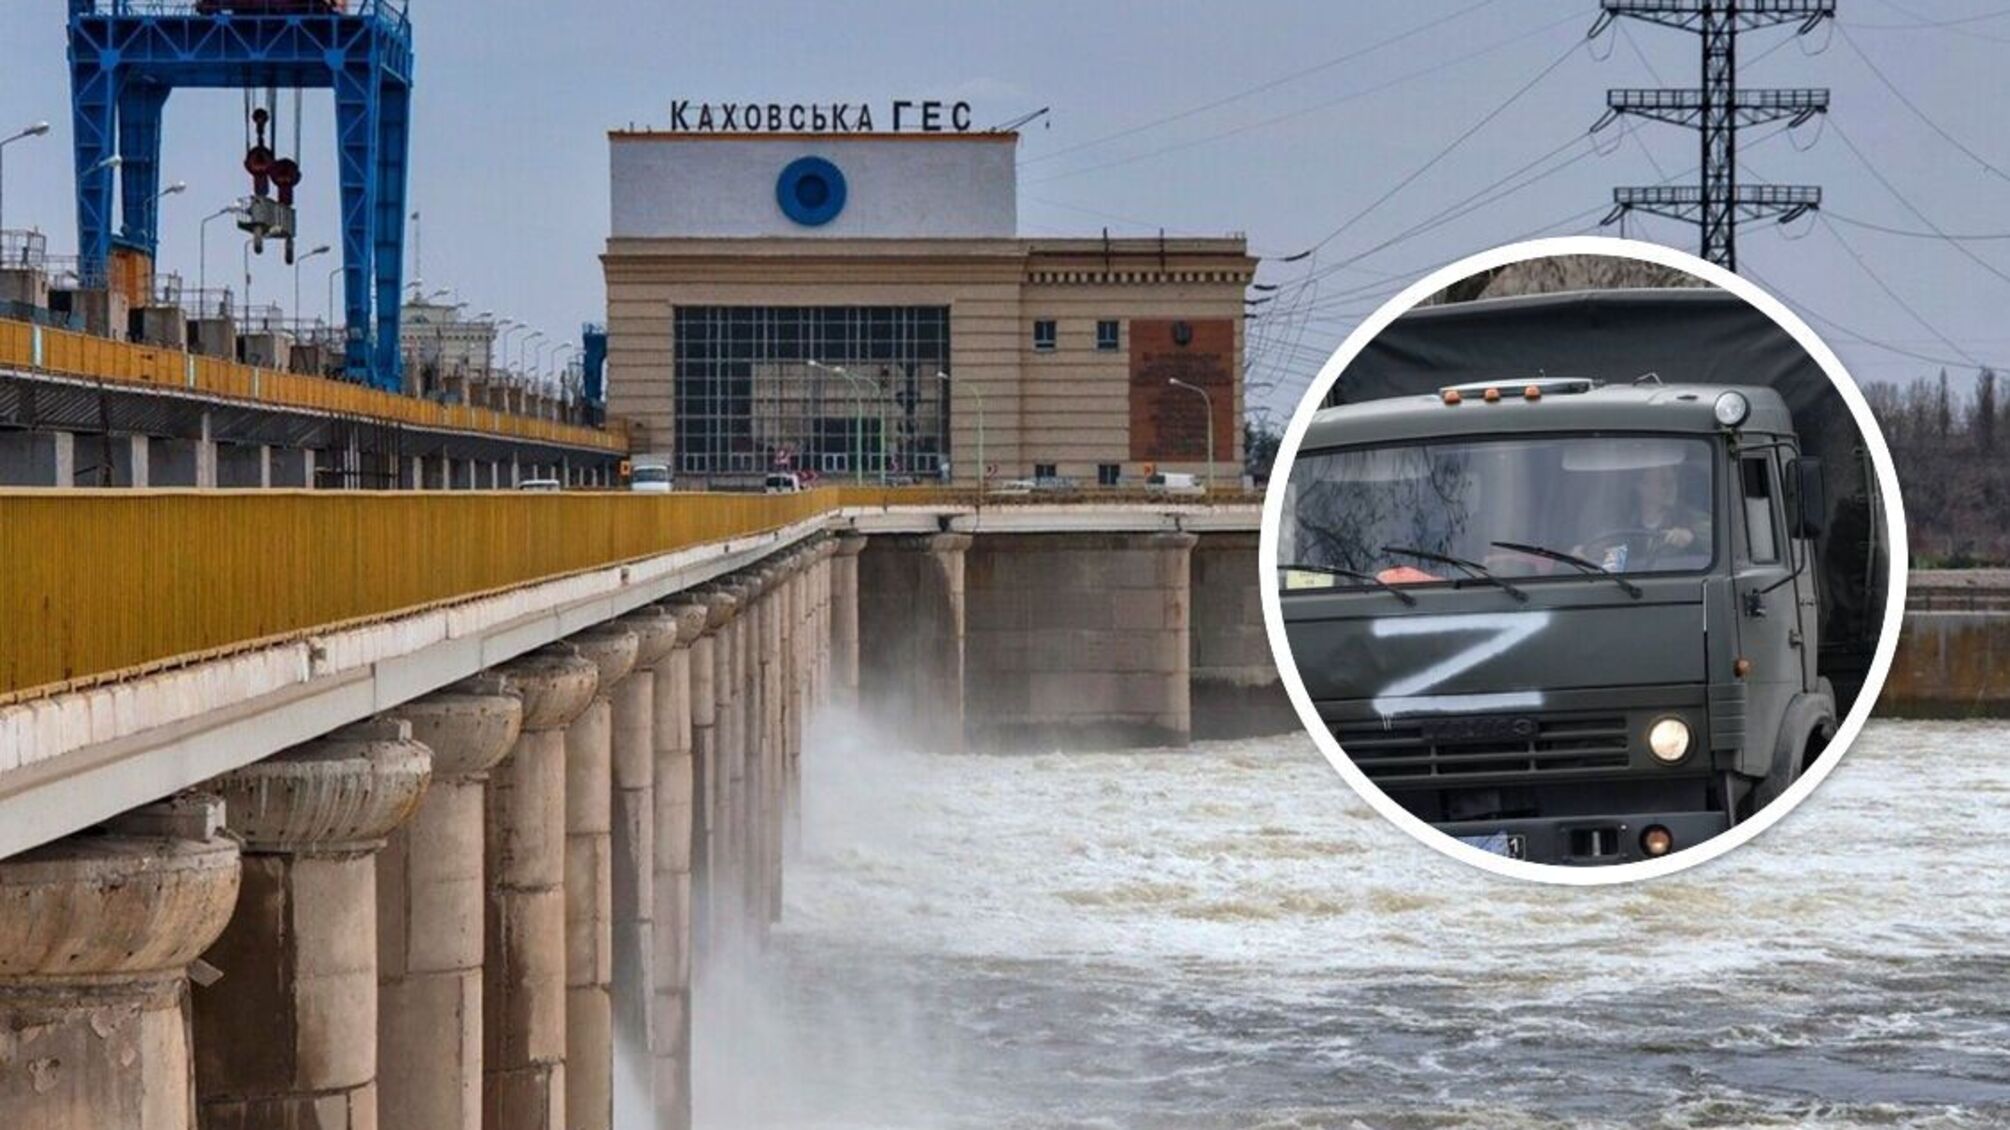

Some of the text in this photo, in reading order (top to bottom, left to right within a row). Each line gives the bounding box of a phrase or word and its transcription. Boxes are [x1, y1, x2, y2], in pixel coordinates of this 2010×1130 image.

[671, 101, 971, 132] КАХОВСЬКА ГЕС
[1372, 611, 1552, 714] Z
